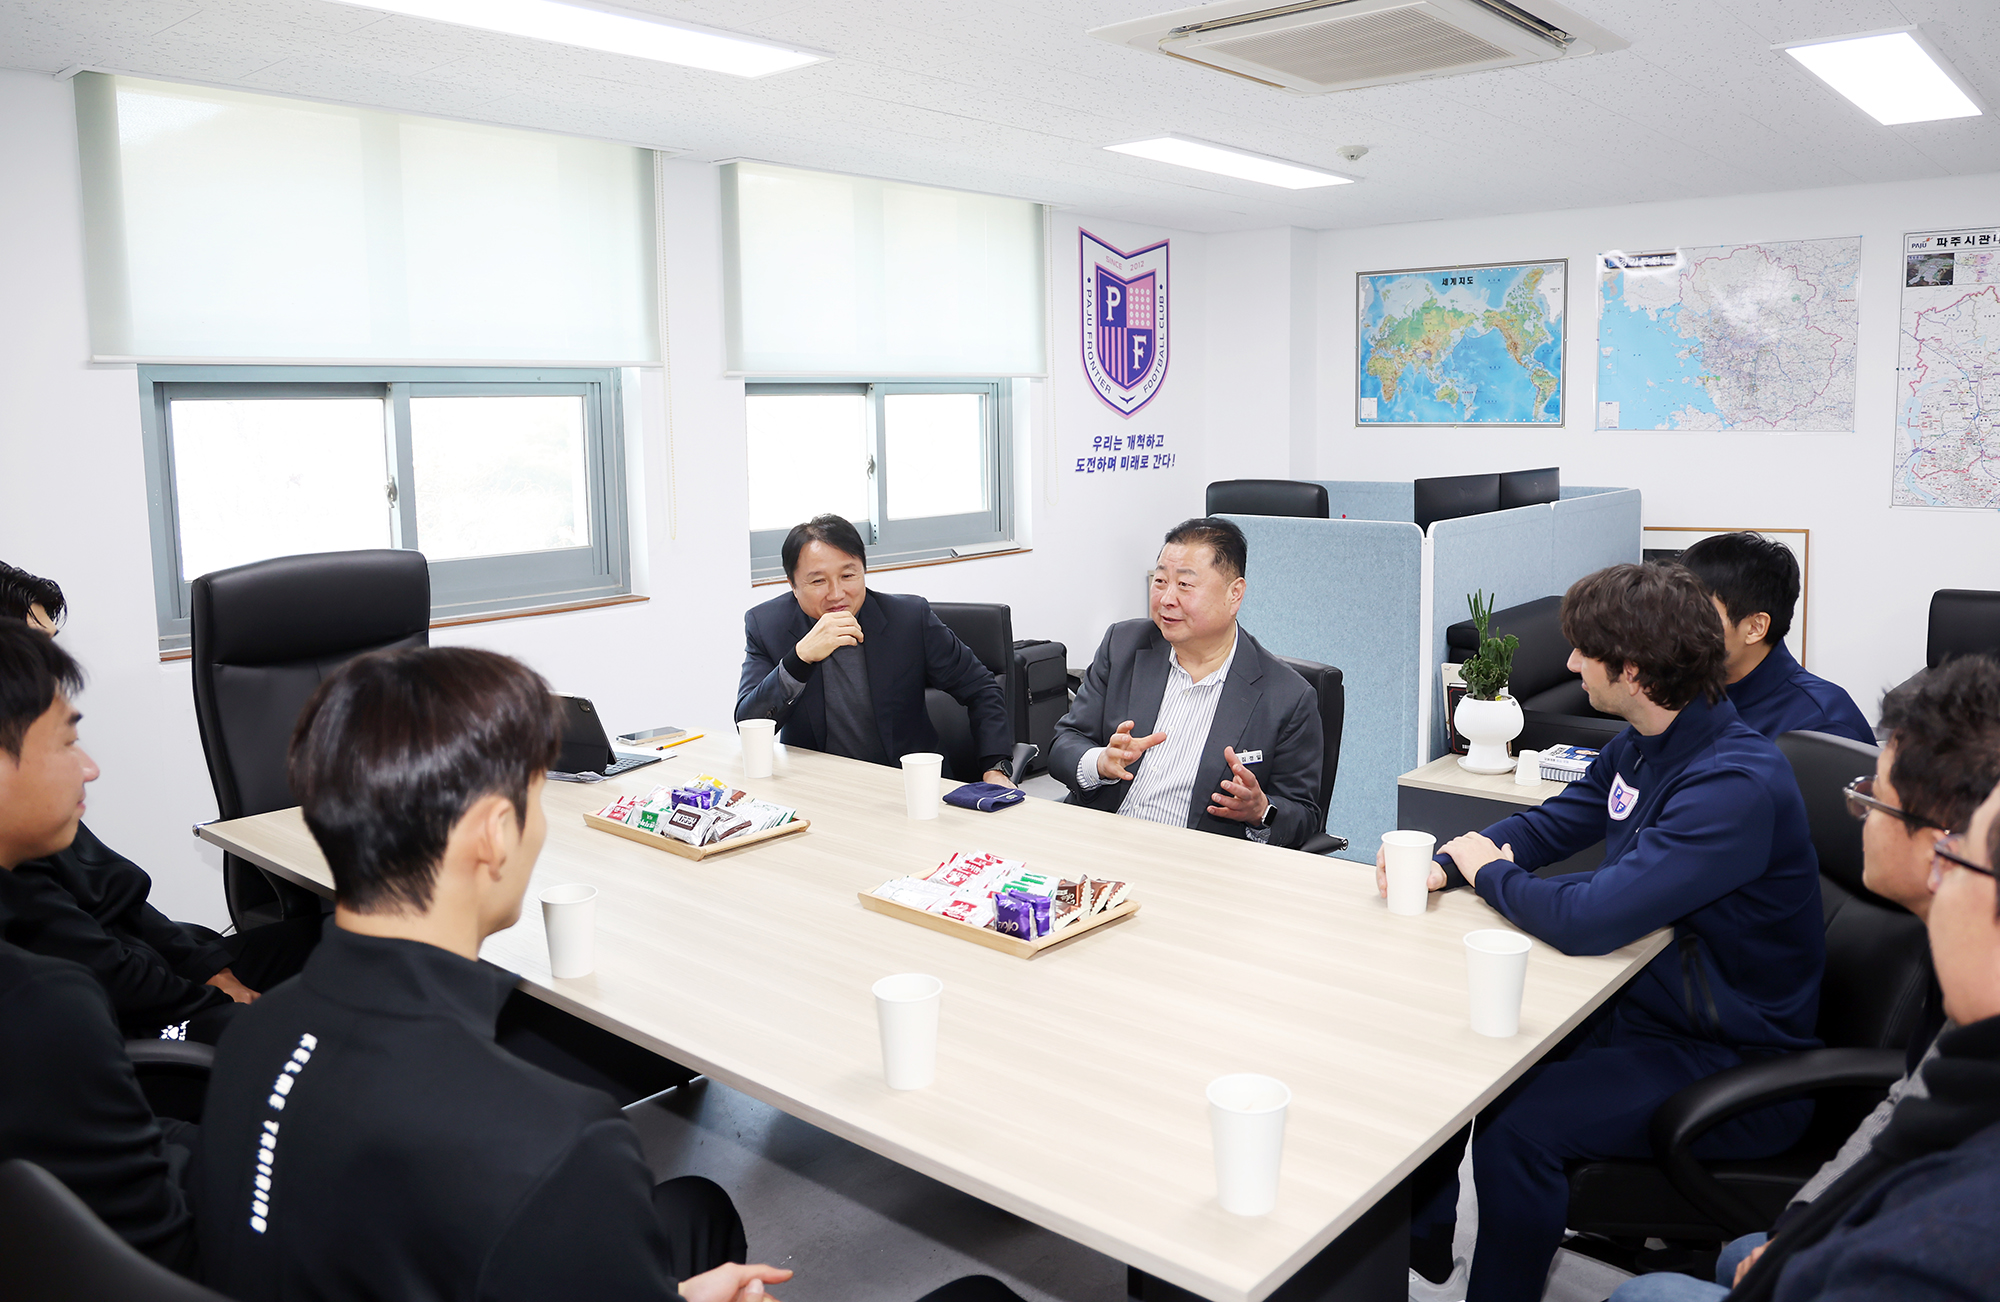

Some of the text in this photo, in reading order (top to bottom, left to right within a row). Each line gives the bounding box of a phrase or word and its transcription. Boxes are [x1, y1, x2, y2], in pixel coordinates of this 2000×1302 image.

[1105, 255, 1146, 272] SINCE 2012
[1441, 276, 1474, 286] 세계지도
[1105, 285, 1121, 322] P
[1086, 331, 1112, 394] FRONTIER
[1132, 334, 1147, 371] F
[1142, 333, 1165, 394] FOOTBALL
[1092, 433, 1165, 452] 우리는 개척하고
[1075, 452, 1176, 473] 도전하며 미래로 간다!
[1615, 788, 1622, 797] P
[1616, 803, 1625, 812] F
[249, 1032, 318, 1235] KELME TRAINING
